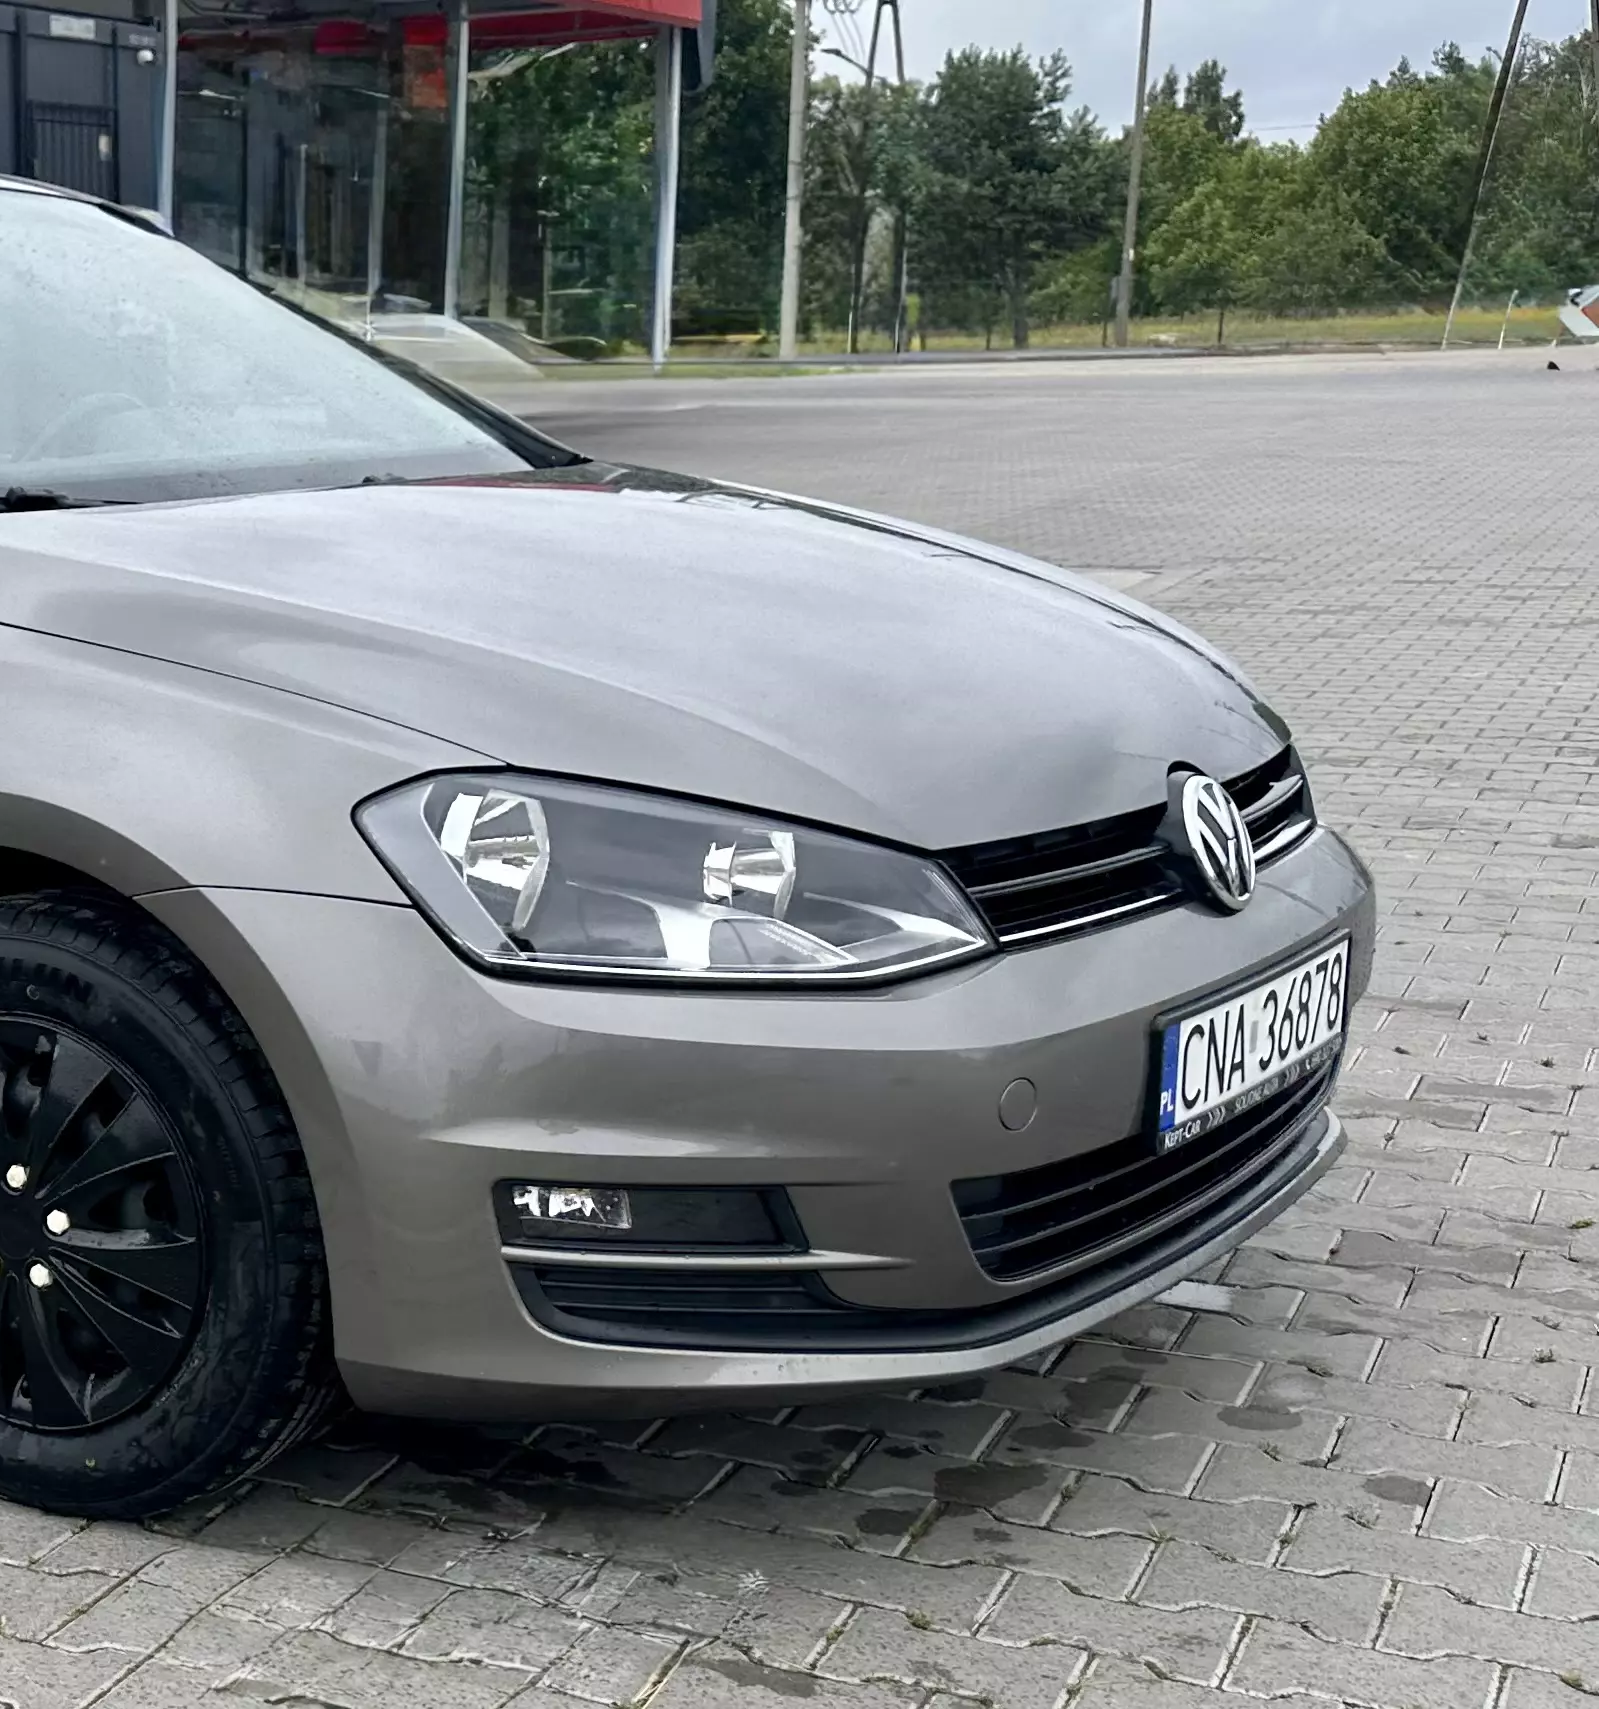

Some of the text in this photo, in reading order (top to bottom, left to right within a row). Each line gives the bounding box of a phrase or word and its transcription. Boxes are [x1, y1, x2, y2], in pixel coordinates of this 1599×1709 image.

[1181, 952, 1342, 1109] CNA 36878
[1160, 1088, 1174, 1116] PL
